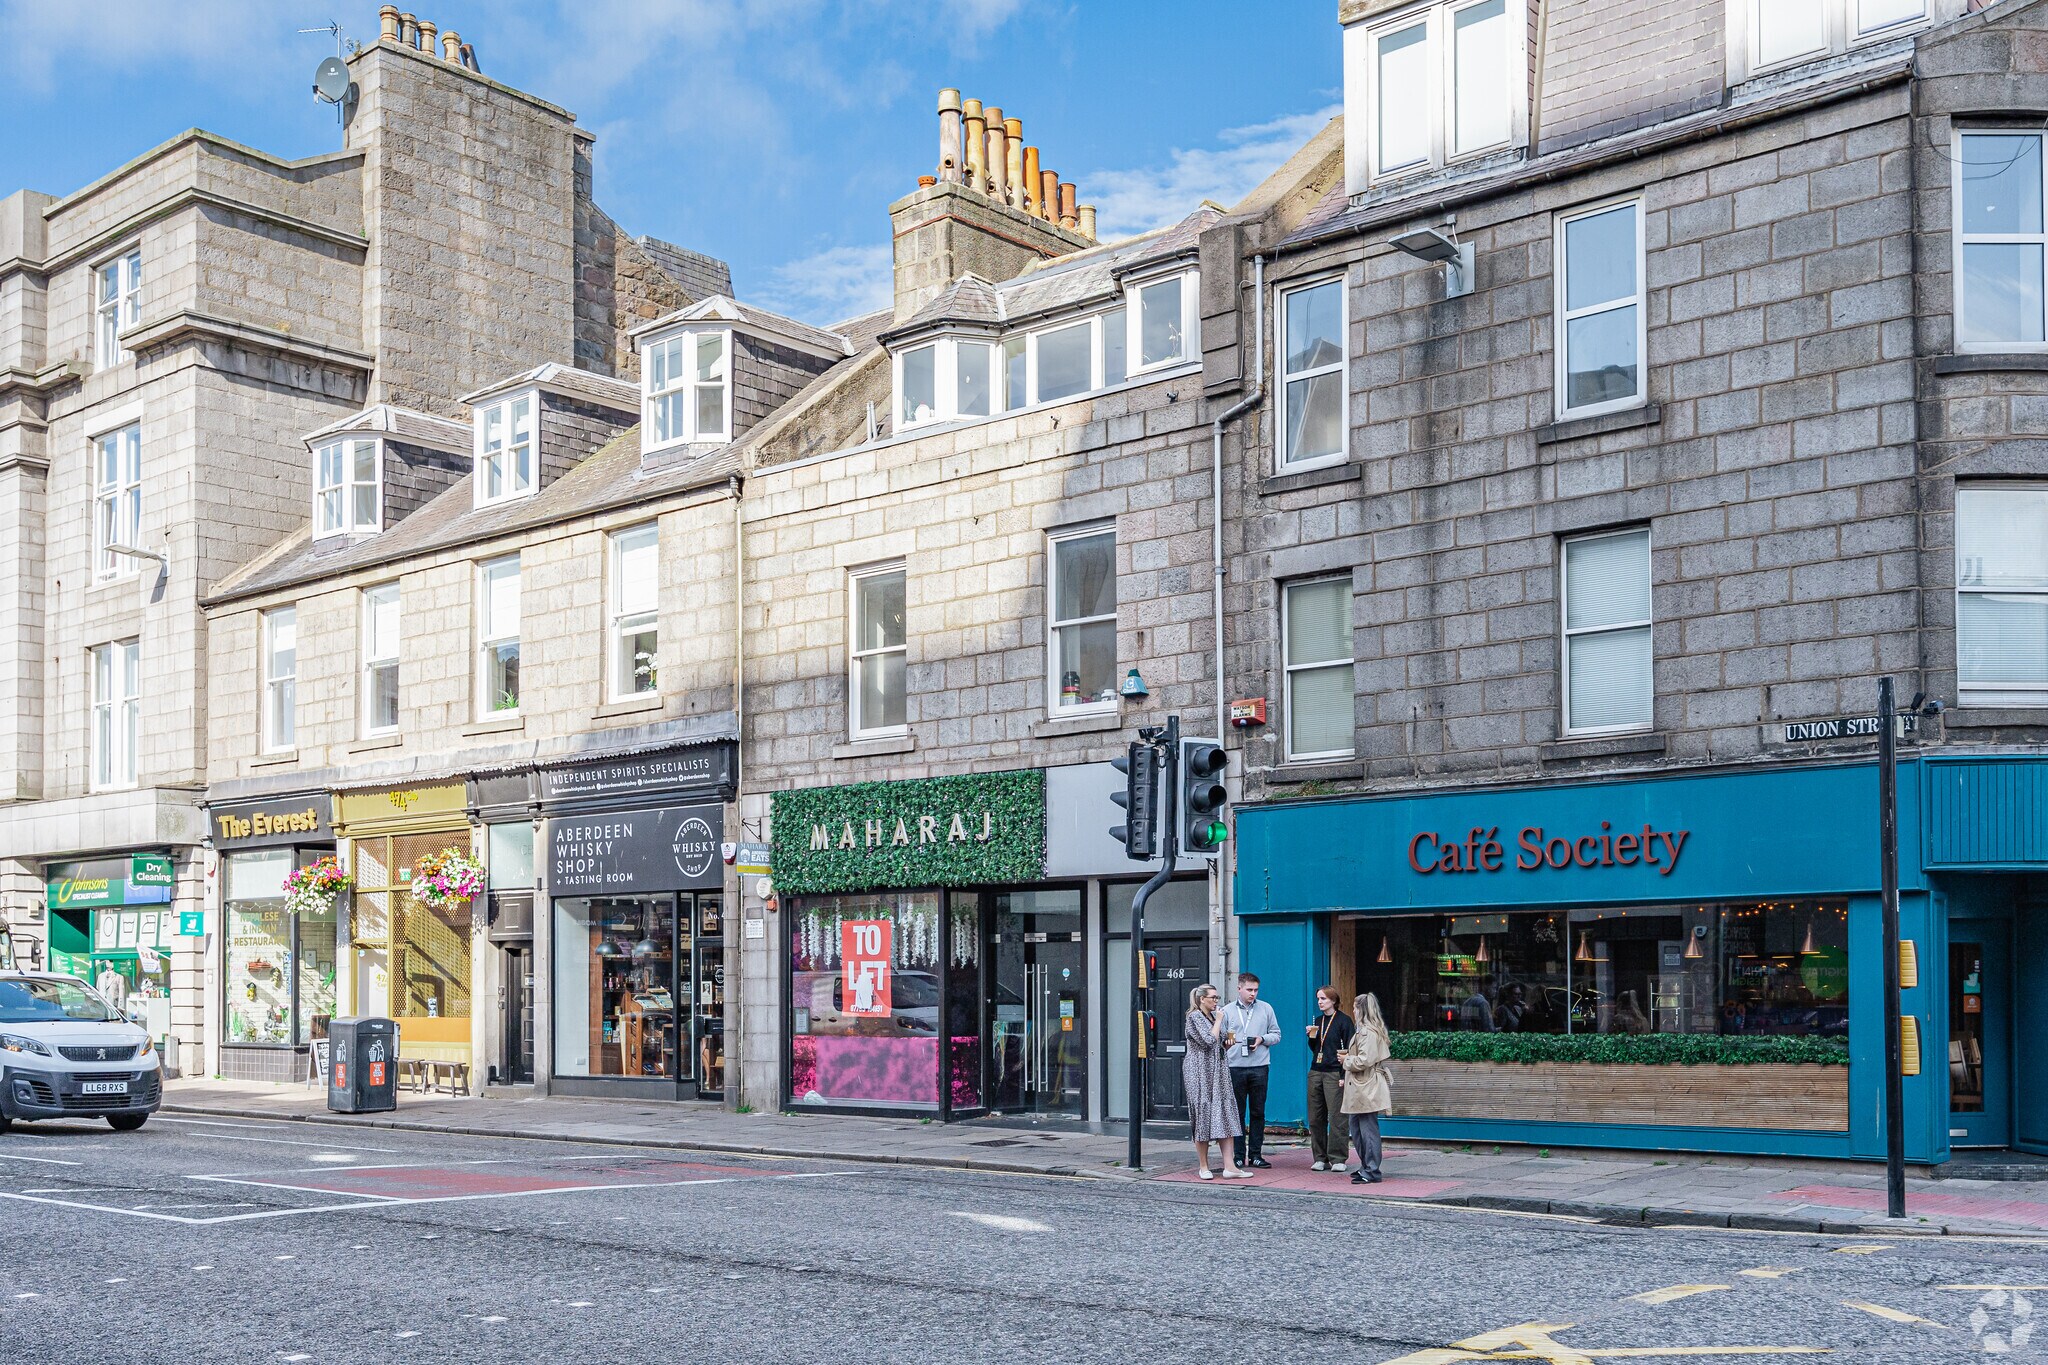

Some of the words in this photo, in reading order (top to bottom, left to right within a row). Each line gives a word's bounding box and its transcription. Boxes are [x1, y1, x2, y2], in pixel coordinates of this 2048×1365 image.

[1786, 721, 1840, 740] UNION
[1846, 715, 1914, 735] STRT
[549, 769, 608, 785] INDEPENDENT
[611, 765, 647, 779] SPIRITS
[650, 758, 710, 774] SPECIALISTS
[218, 814, 252, 838] The
[252, 808, 318, 835] Everest
[680, 822, 708, 838] ABERDEEN
[556, 823, 633, 842] ABERDEEN
[809, 812, 991, 851] MAHARAJ
[556, 841, 613, 858] WHISKY
[672, 841, 716, 853] WHISKY
[1408, 826, 1503, 873] Café
[1516, 821, 1689, 875] Society
[146, 863, 162, 872] Dry
[556, 858, 595, 874] SHOP
[687, 864, 701, 872] SHOP
[57, 864, 109, 903] Johnsons
[136, 872, 172, 883] Cleaning
[565, 874, 602, 885] TASTING
[606, 872, 633, 882] ROOM
[243, 925, 248, 935] &
[249, 923, 277, 934] INDIAN
[234, 935, 286, 947] RESTAURANT
[853, 925, 882, 956] TO
[847, 961, 887, 991] LET
[1167, 968, 1185, 979] 468
[85, 1084, 107, 1092] LL68
[108, 1083, 124, 1091] RXS
